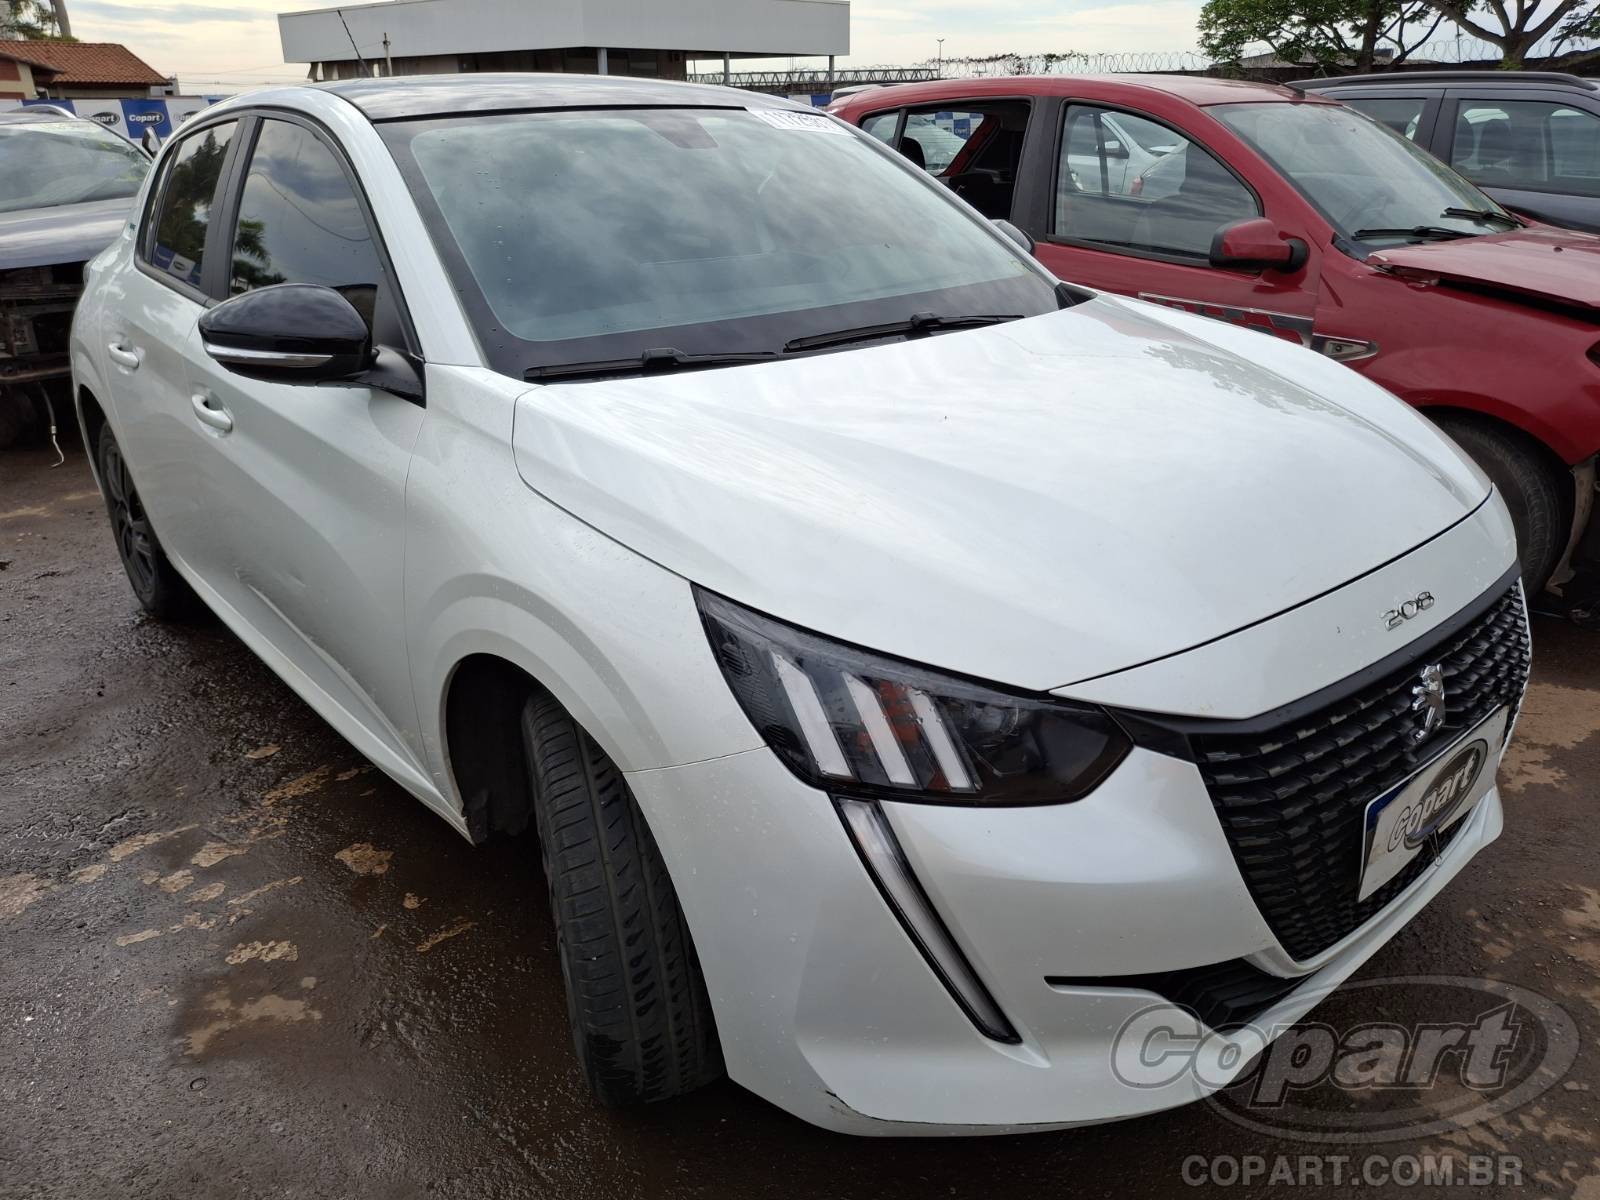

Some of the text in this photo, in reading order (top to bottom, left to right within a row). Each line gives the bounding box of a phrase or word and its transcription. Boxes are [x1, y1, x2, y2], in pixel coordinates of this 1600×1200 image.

[128, 114, 161, 123] Copart
[1380, 591, 1435, 631] 208
[1387, 748, 1480, 853] Copart
